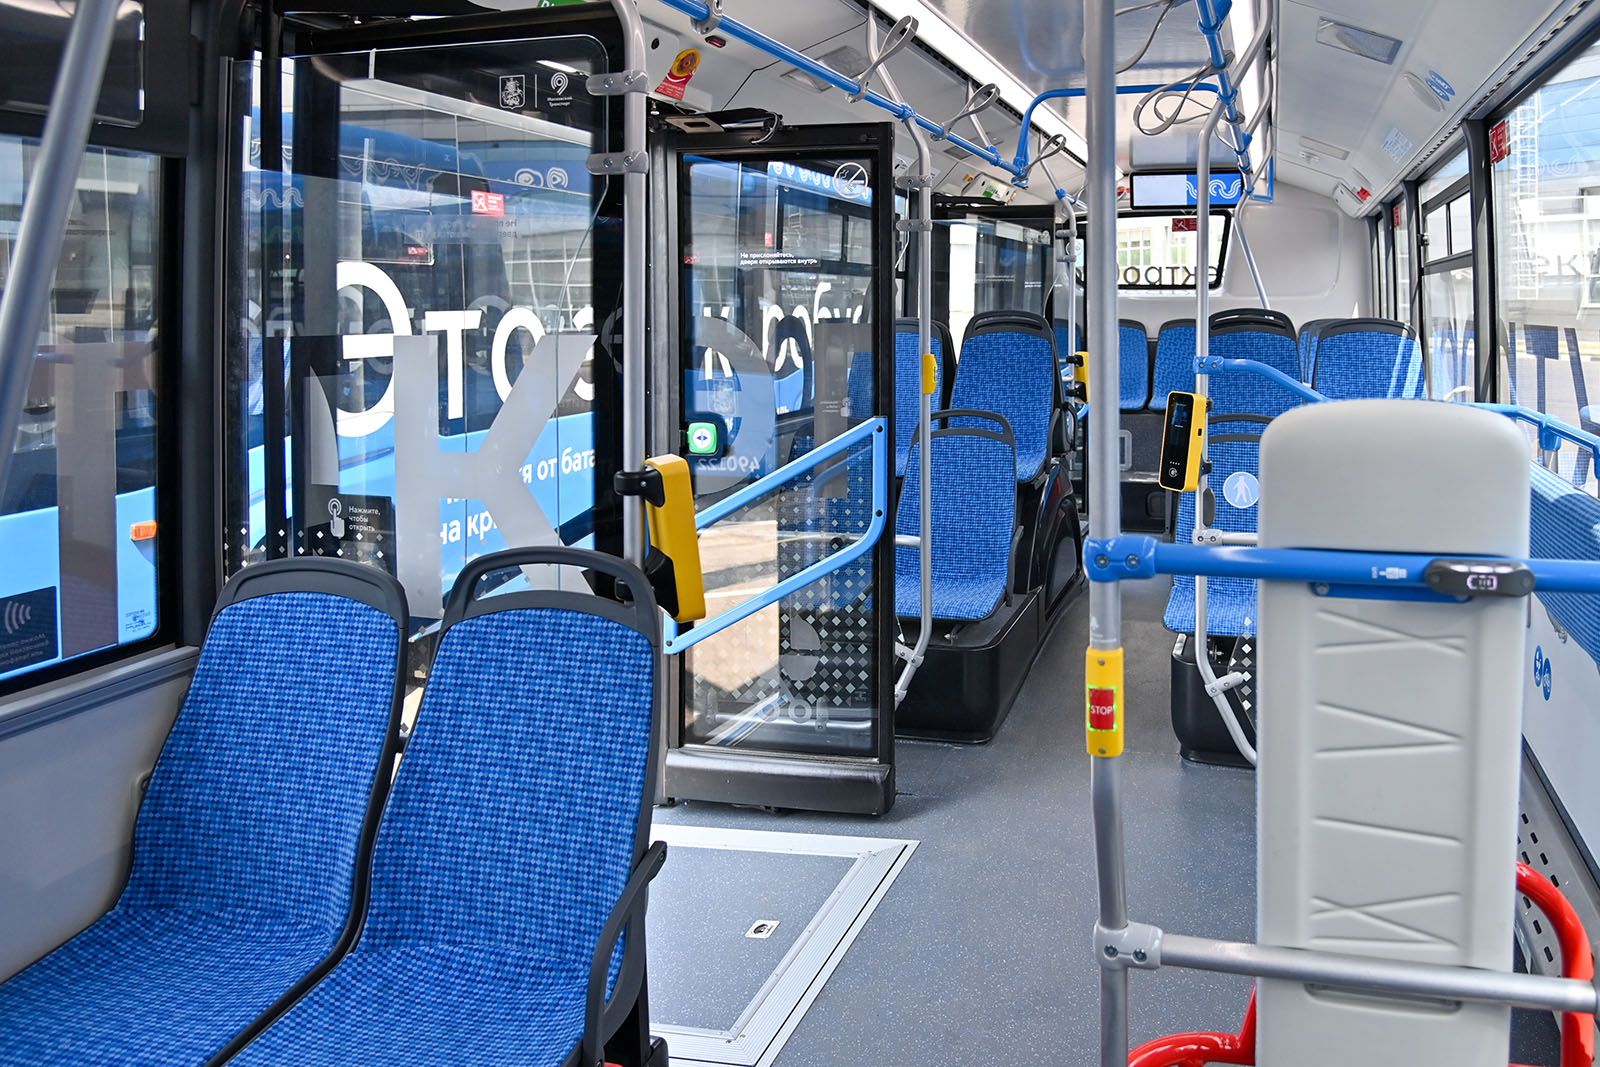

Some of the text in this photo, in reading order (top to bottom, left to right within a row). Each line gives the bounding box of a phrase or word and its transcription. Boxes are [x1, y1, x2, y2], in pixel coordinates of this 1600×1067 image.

[537, 458, 558, 481] от
[349, 506, 381, 515] Нажмите,
[349, 515, 369, 523] чтобы
[349, 524, 376, 532] открыть
[467, 510, 498, 540] кр
[1090, 705, 1113, 715] STOP
